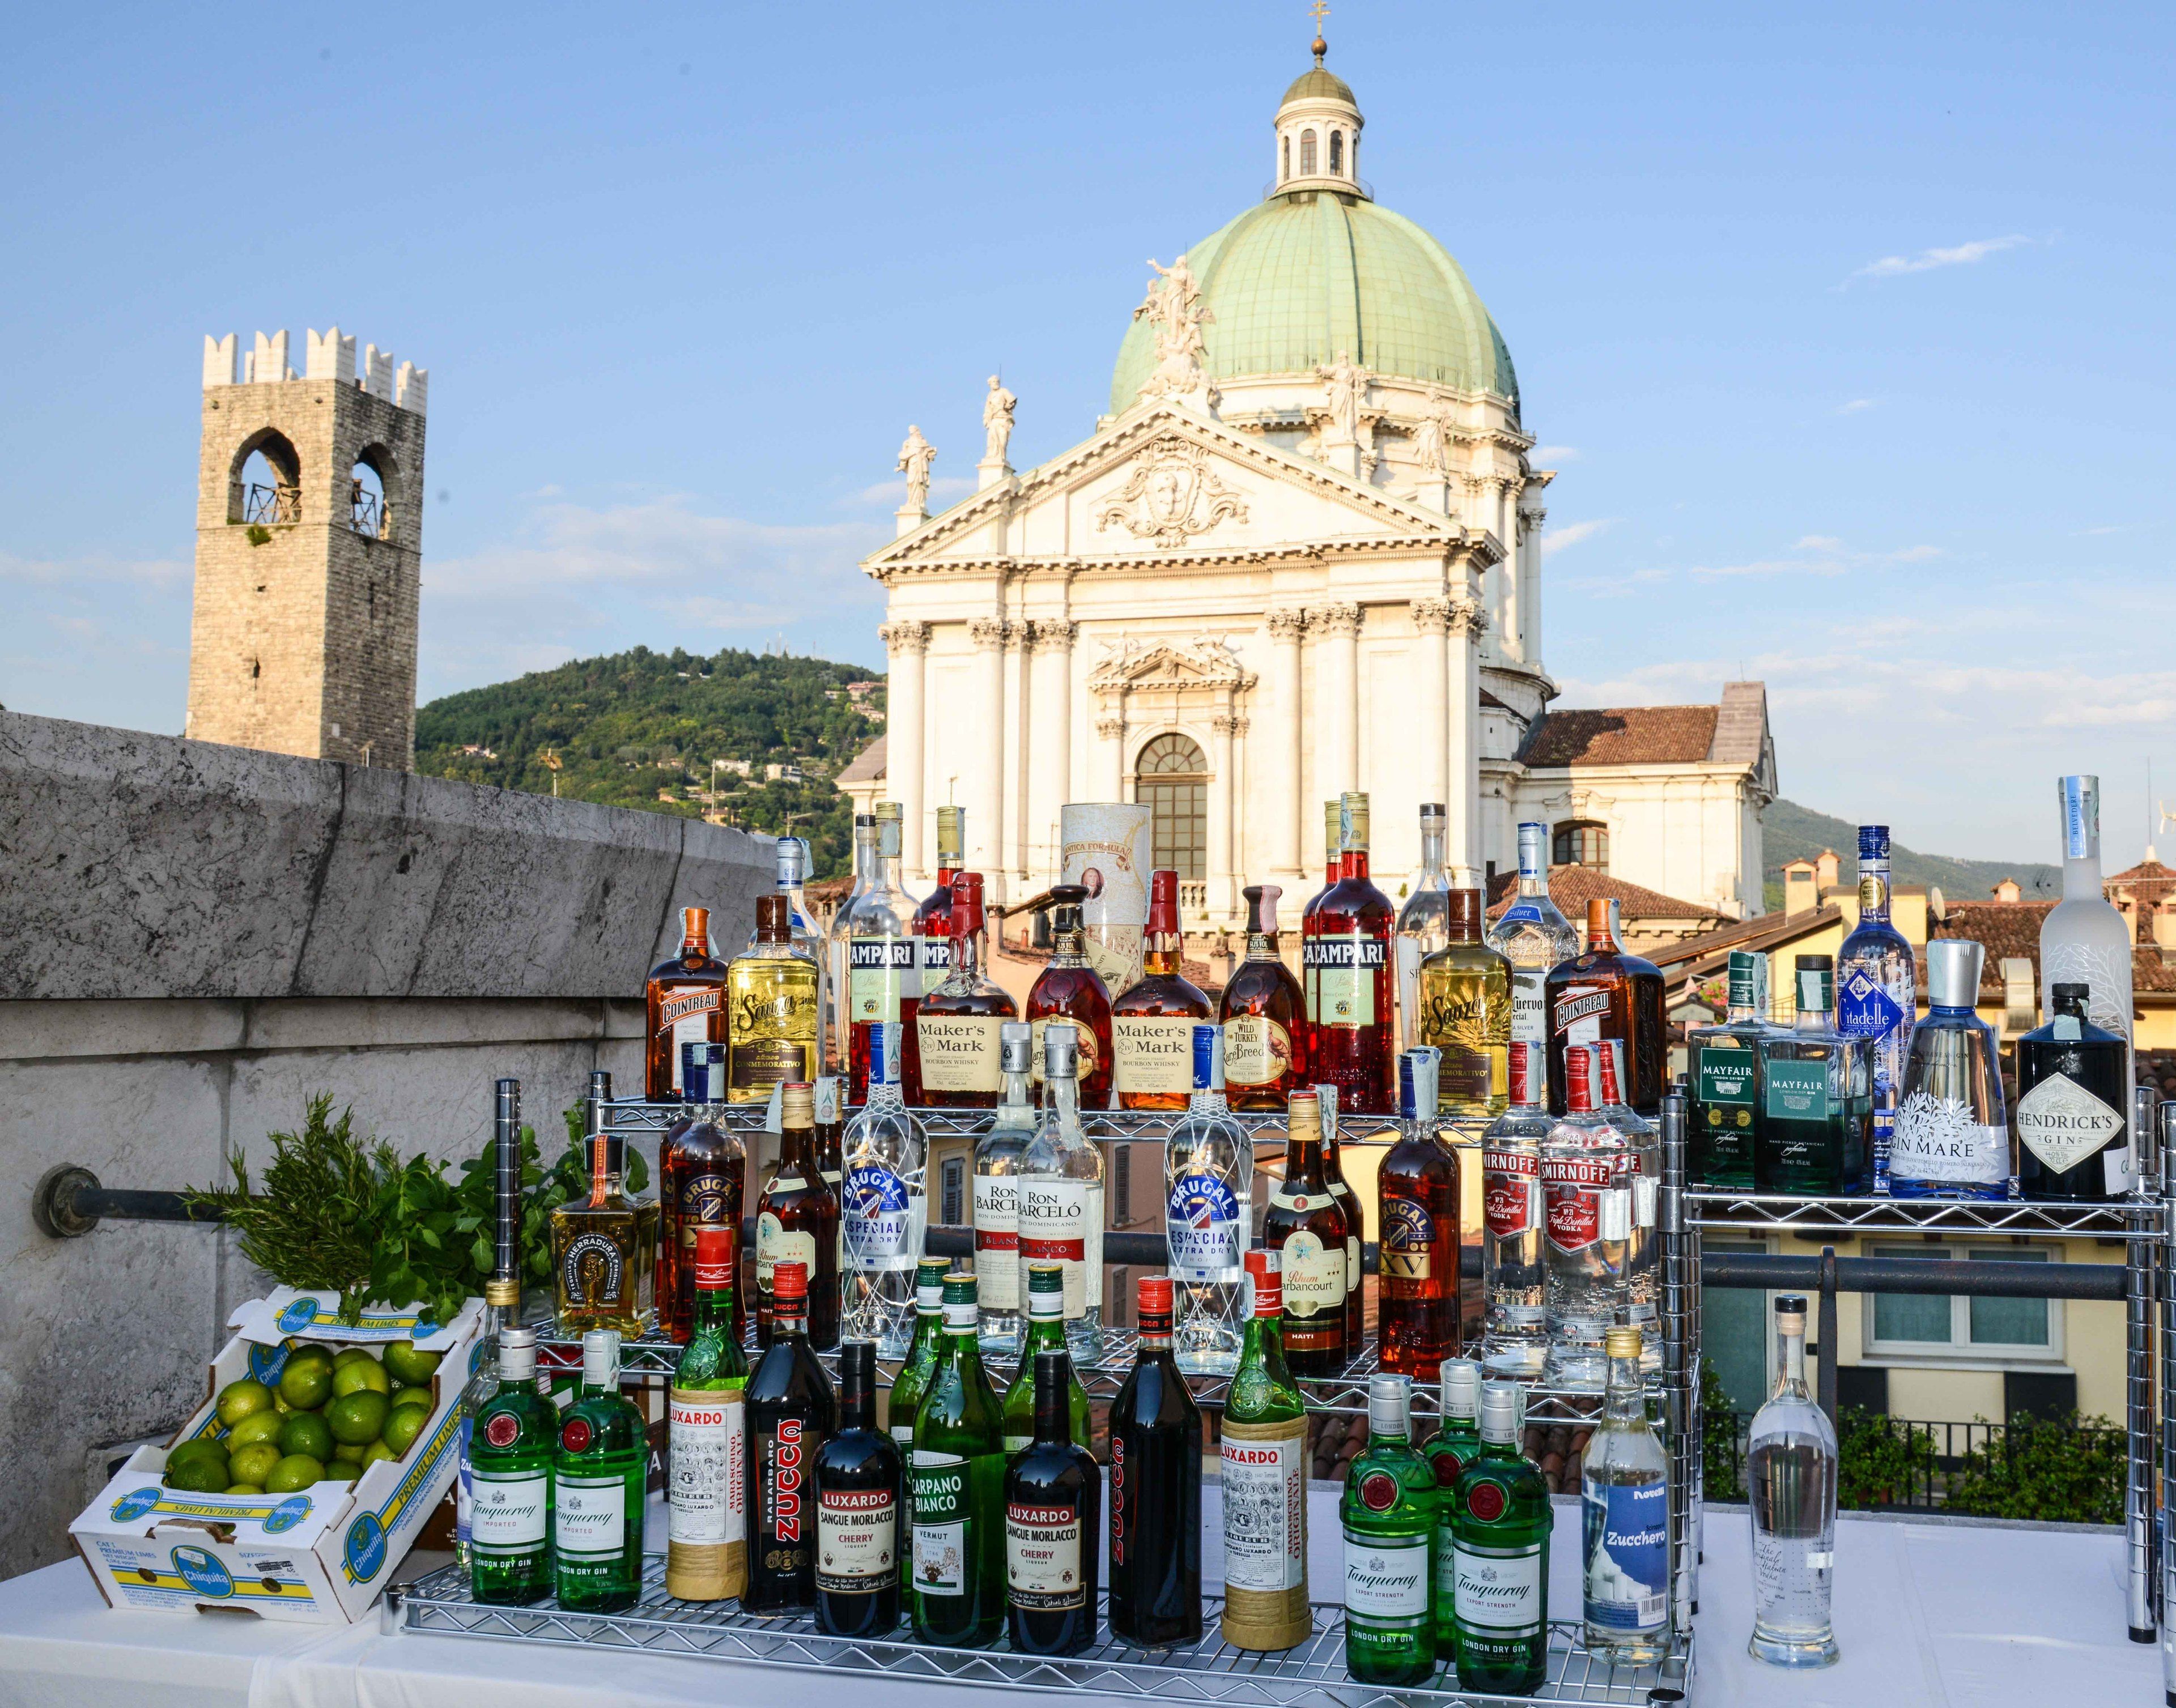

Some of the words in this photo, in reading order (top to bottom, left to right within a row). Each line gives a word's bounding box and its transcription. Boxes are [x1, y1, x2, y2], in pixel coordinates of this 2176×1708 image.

[2070, 794, 2079, 835] BELVEDERE
[1065, 844, 1085, 852] ANTICA
[1087, 842, 1128, 855] FORMULA
[1508, 909, 1532, 918] Silver
[850, 945, 911, 964] AMPARI
[1315, 944, 1383, 964] CAMPARI
[663, 993, 719, 1024] COINTREAU
[737, 994, 797, 1032] Sauza
[1427, 995, 1486, 1036] Sauza
[1557, 993, 1609, 1029] COINTREAU
[1839, 997, 1889, 1026] Citadelle
[920, 1024, 985, 1036] Maker's
[1116, 1025, 1187, 1037] Maker's
[1237, 1024, 1254, 1033] WILD
[1234, 1033, 1259, 1043] TURKEY
[936, 1040, 984, 1052] Mark
[1135, 1041, 1187, 1053] Mark
[1236, 1043, 1265, 1058] Breed
[1703, 1066, 1753, 1076] MAYFAIR
[1771, 1080, 1824, 1091] MAYFAIR
[2018, 1111, 2113, 1129] HENDRICK'S
[1891, 1135, 1911, 1152] GIN
[1915, 1142, 1975, 1157] MARE
[2044, 1135, 2075, 1144] GIN
[1541, 1164, 1608, 1182] SMIRNOFF
[844, 1171, 902, 1201] BRUGAL
[1028, 1191, 1058, 1204] RON
[1171, 1180, 1233, 1210] BRUGAL
[703, 1198, 721, 1219] BRUGAL
[1297, 1198, 1304, 1208] 4
[1495, 1204, 1524, 1215] Distilled
[1382, 1202, 1427, 1232] RUGAL
[1548, 1213, 1564, 1227] Triple
[1562, 1215, 1596, 1226] Distilled
[1171, 1230, 1234, 1245] ESPECIAL
[568, 1238, 617, 1259] HERRADURA
[758, 1249, 778, 1262] Rhum
[1173, 1246, 1204, 1254] EXTRA
[1380, 1253, 1426, 1276] XV
[610, 1264, 618, 1290] ORIGINAL
[1287, 1270, 1319, 1283] Rhum
[283, 1314, 310, 1326] Chiquita
[330, 1317, 376, 1328] PREUM
[376, 1319, 400, 1328] LIMES
[258, 1351, 290, 1385] Chiquita
[670, 1408, 723, 1425] UXARDO
[397, 1444, 439, 1506] PREMIUM
[439, 1405, 461, 1443] LIMES
[1221, 1445, 1278, 1464] LUXARDO
[776, 1419, 802, 1542] ZUCCA
[912, 1475, 962, 1494] CARPANO
[125, 1496, 156, 1507] Chiquita
[824, 1493, 888, 1507] LUXARDO
[915, 1494, 957, 1513] BIANCO
[1112, 1436, 1124, 1566] ZUCCA
[172, 1503, 203, 1514] LIMES
[202, 1506, 253, 1517] PREMIUM
[274, 1505, 305, 1516] Chiquita
[473, 1498, 537, 1520] Tanqueray
[555, 1504, 614, 1526] Tanqueray
[1009, 1506, 1070, 1523] LUXARDO
[821, 1511, 849, 1526] SANGUE
[851, 1509, 893, 1526] MORLACCO
[838, 1534, 874, 1543] CHERRY
[919, 1530, 948, 1540] VERMUT
[1007, 1523, 1030, 1541] SANGUE
[1031, 1530, 1077, 1542] MORLACCO
[1606, 1530, 1666, 1547] Zucchero
[100, 1547, 135, 1557] PREMIUM
[135, 1550, 157, 1560] LIMES
[354, 1532, 384, 1573] Chiquita
[1021, 1548, 1055, 1559] CHERRY
[475, 1558, 498, 1568] LONDON
[500, 1559, 515, 1568] DRY
[518, 1558, 532, 1567] GIN
[184, 1571, 230, 1585] Chiquita
[594, 1567, 608, 1575] GIN
[1347, 1564, 1419, 1590] Tanqueray
[1355, 1588, 1372, 1597] EXPORT
[1457, 1573, 1531, 1600] Tanqueray
[1466, 1598, 1485, 1607] EXPORT
[1351, 1628, 1378, 1642] LONDON
[1400, 1634, 1414, 1642] GIN
[1462, 1638, 1490, 1652] LONDON
[1493, 1645, 1509, 1653] DRY
[1512, 1644, 1527, 1652] GIN
